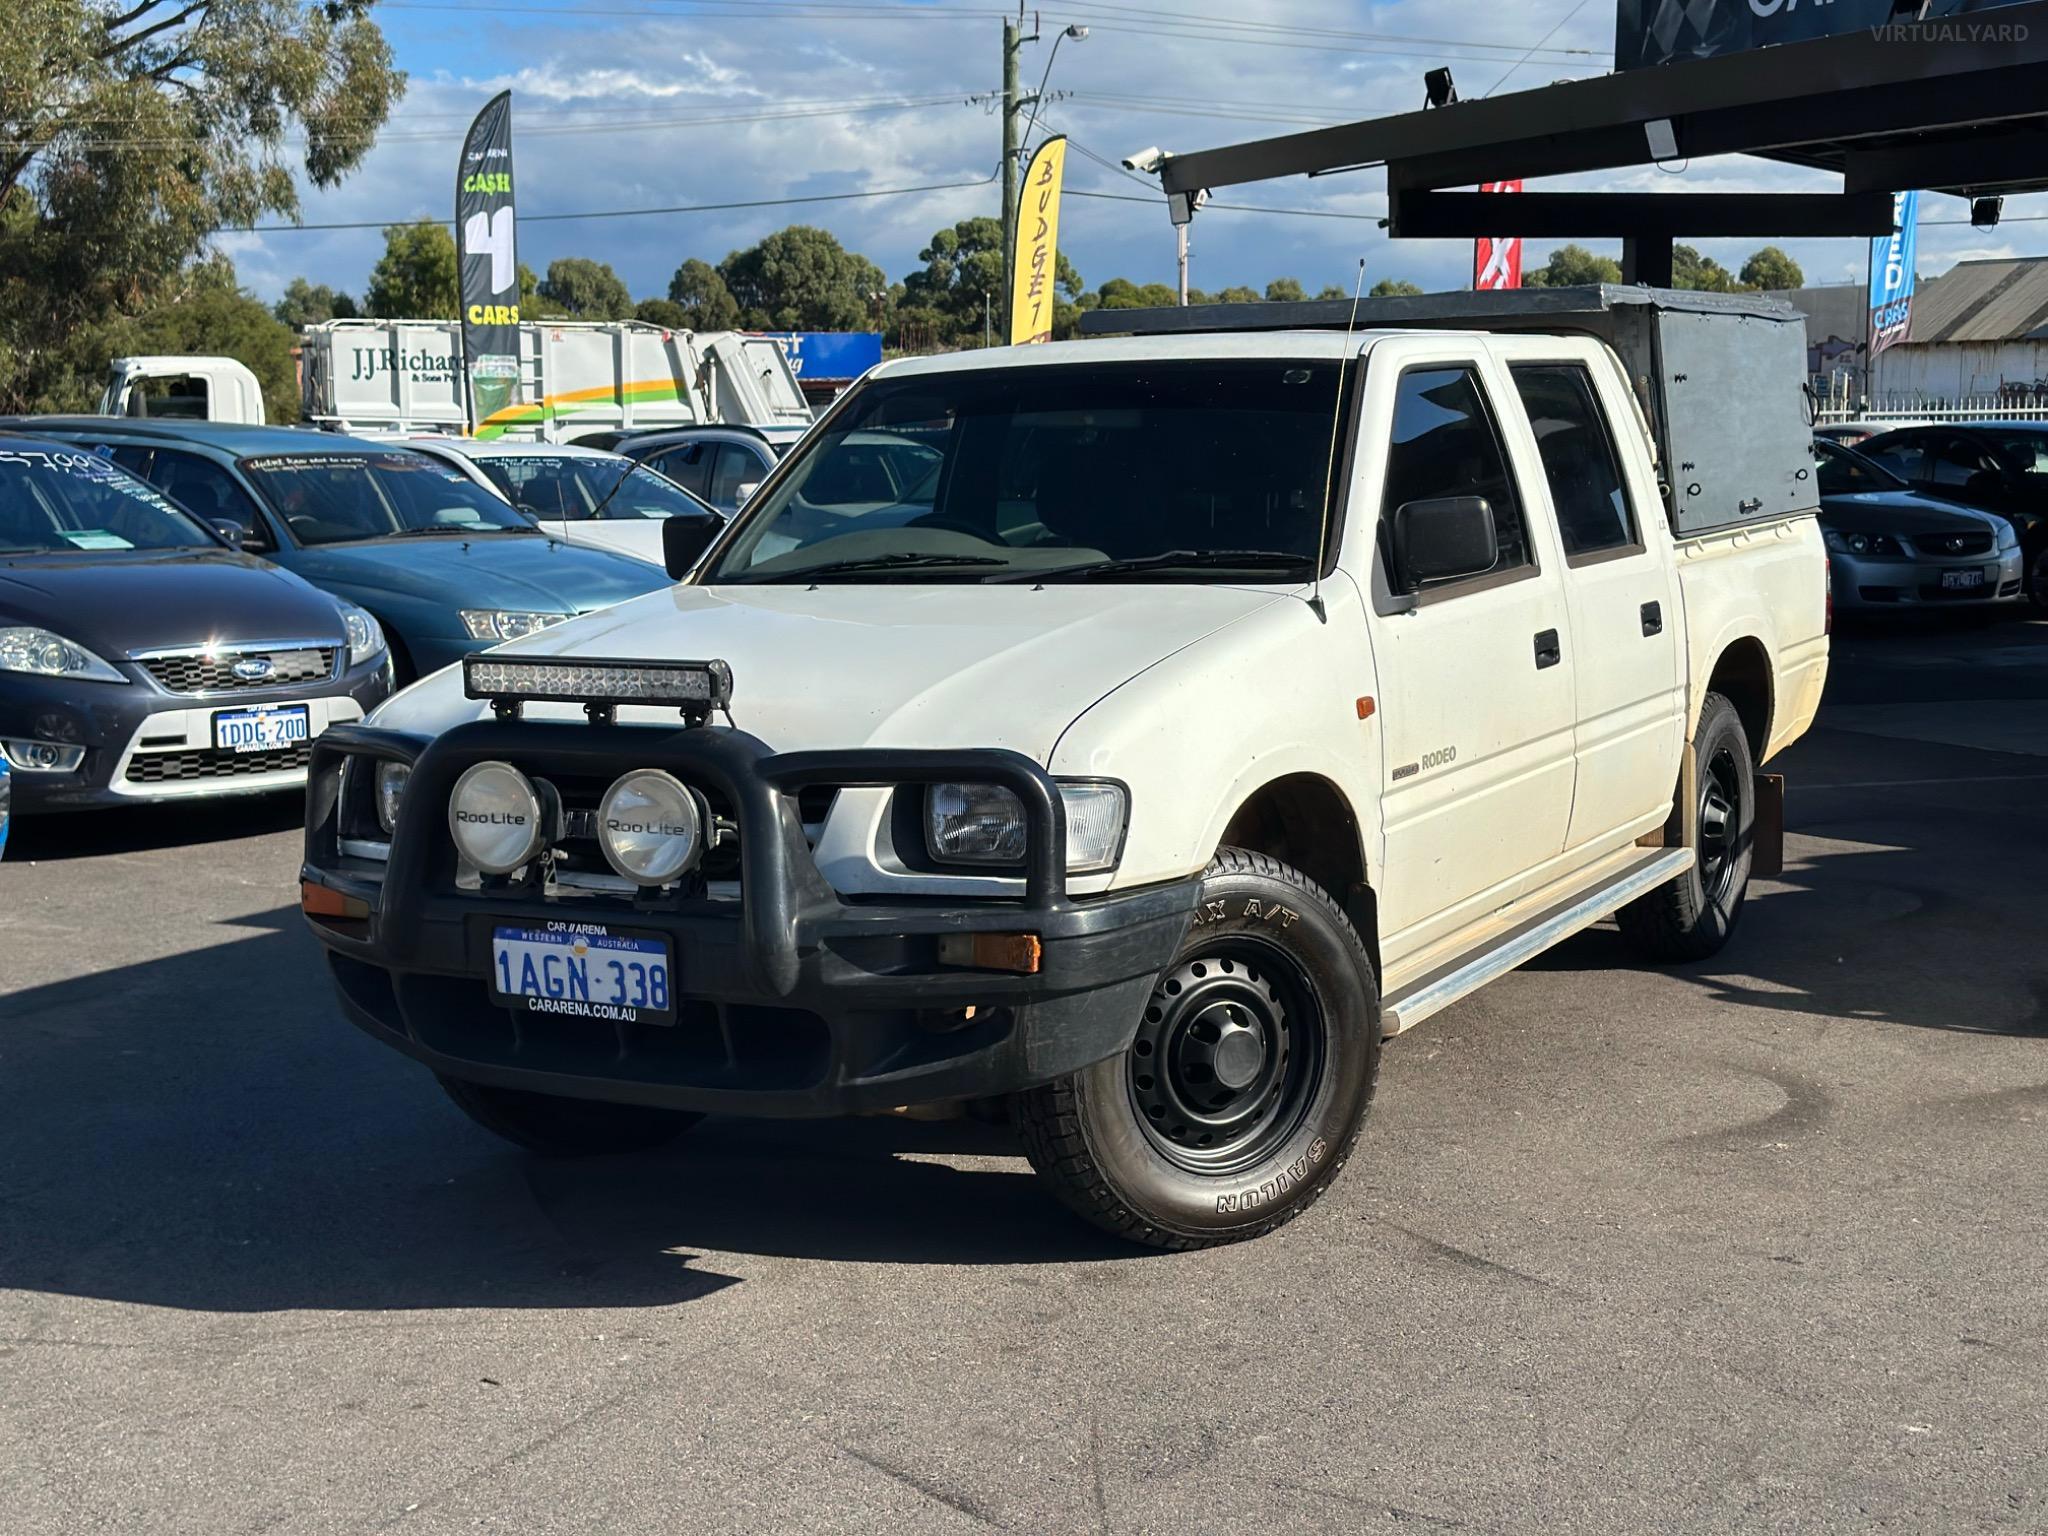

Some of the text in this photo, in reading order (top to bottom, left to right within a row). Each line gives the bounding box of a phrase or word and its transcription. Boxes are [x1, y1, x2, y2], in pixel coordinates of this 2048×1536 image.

[465, 206, 515, 295] 4
[1027, 159, 1054, 327] BUDGET
[469, 304, 519, 326] CARS
[1421, 745, 1457, 770] RODEO
[1243, 898, 1299, 928] A/T
[521, 931, 639, 951] WESTERN AUSTRALIA
[528, 997, 637, 1022] CARARENA.COM.AU
[1217, 1137, 1327, 1214] SAILUN
